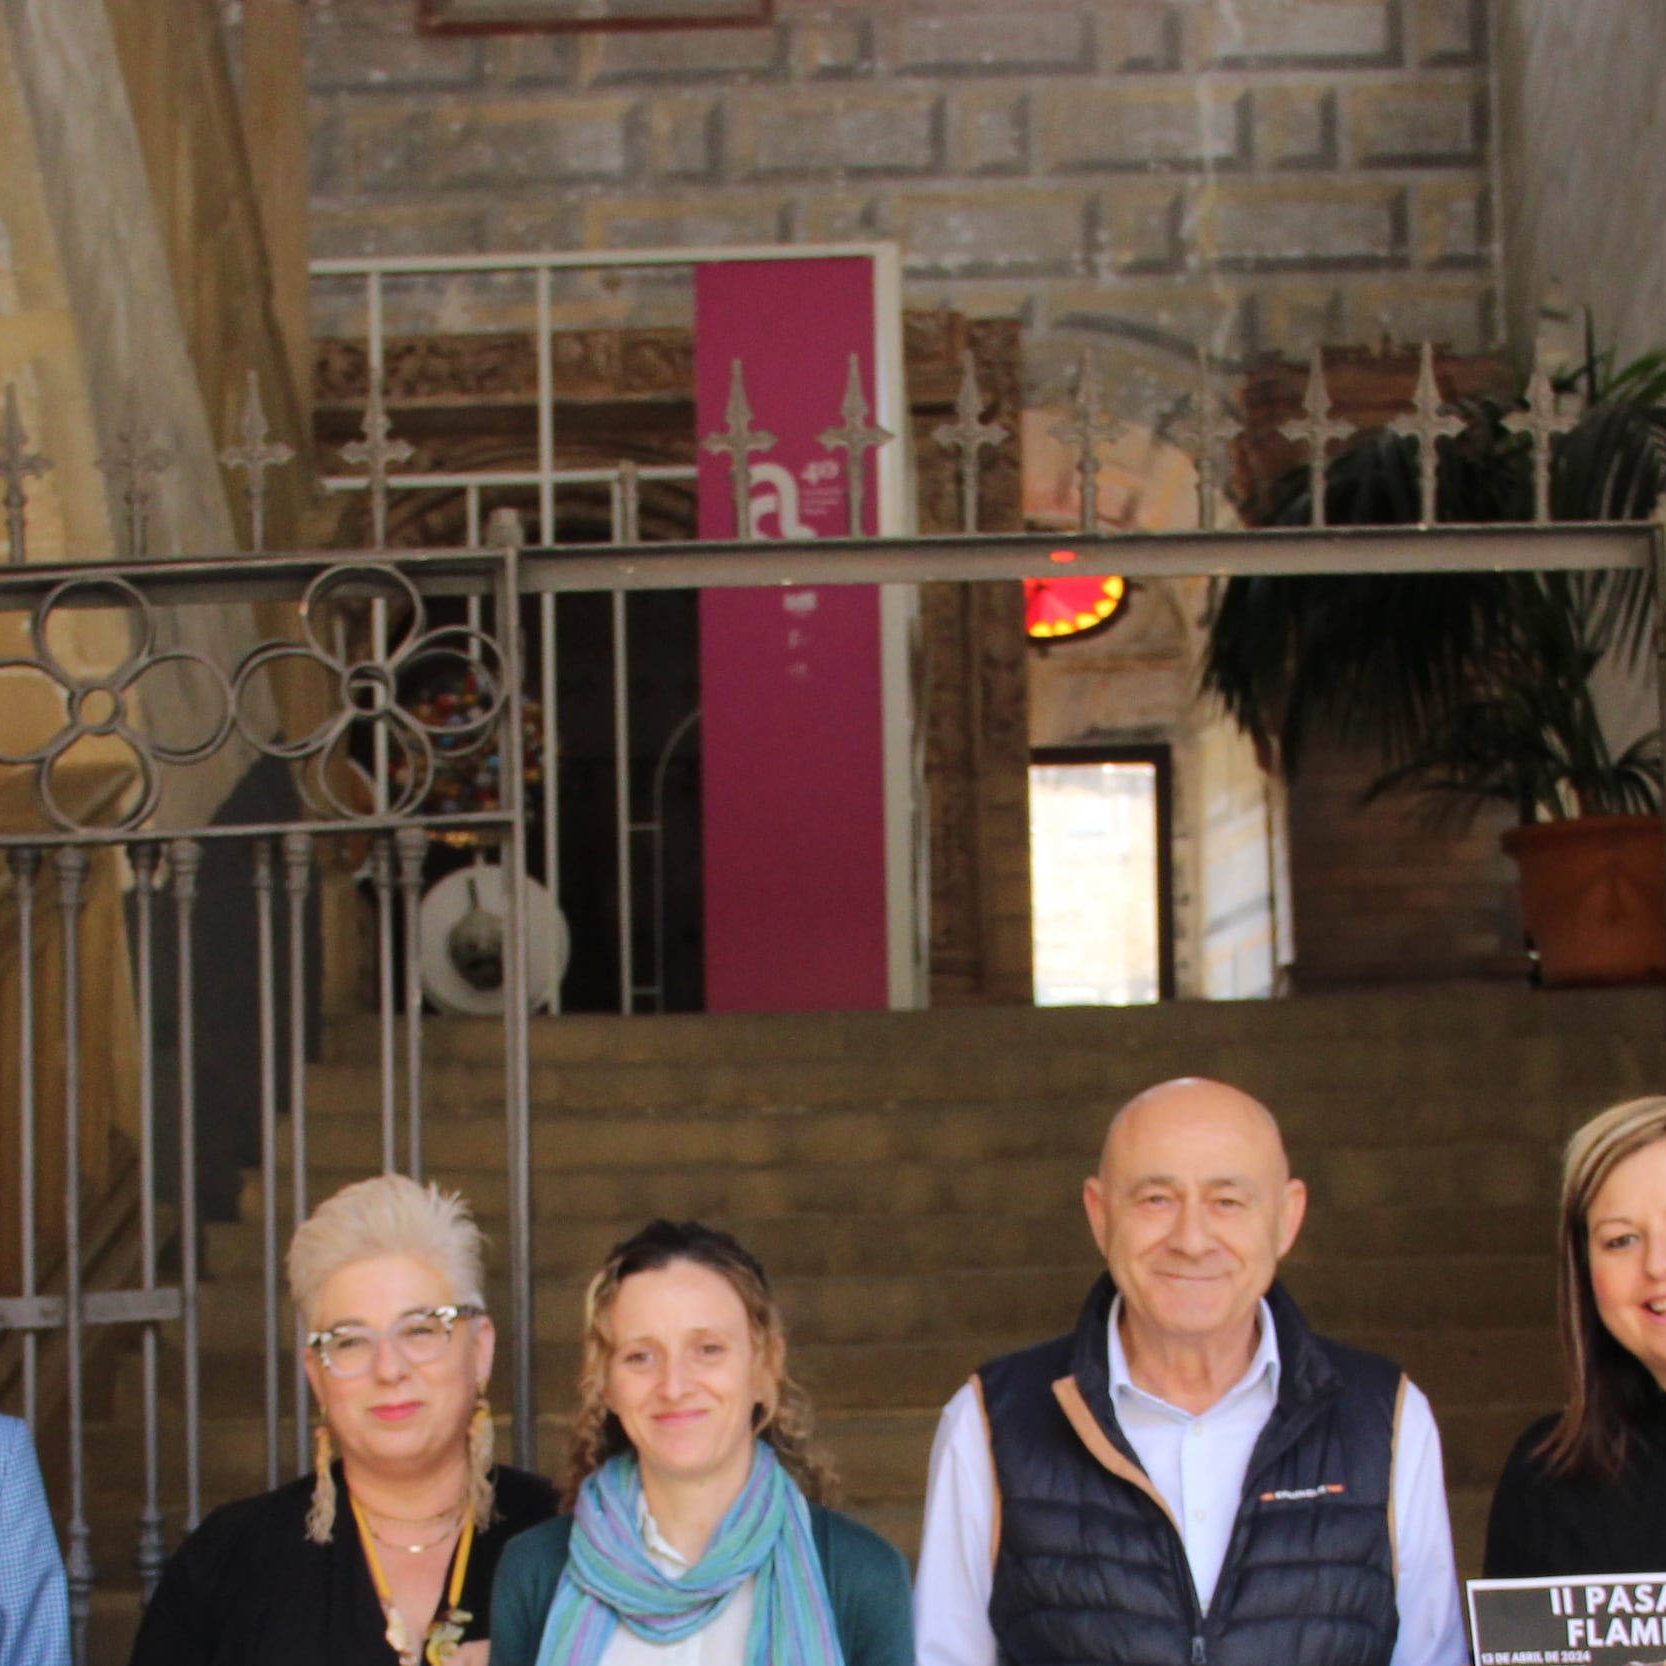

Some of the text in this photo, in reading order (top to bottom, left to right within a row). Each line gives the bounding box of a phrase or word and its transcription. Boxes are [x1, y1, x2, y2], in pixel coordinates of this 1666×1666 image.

[1552, 1587, 1572, 1615] II
[1482, 1651, 1591, 1663] 13 DE ABRIL DE 2024
